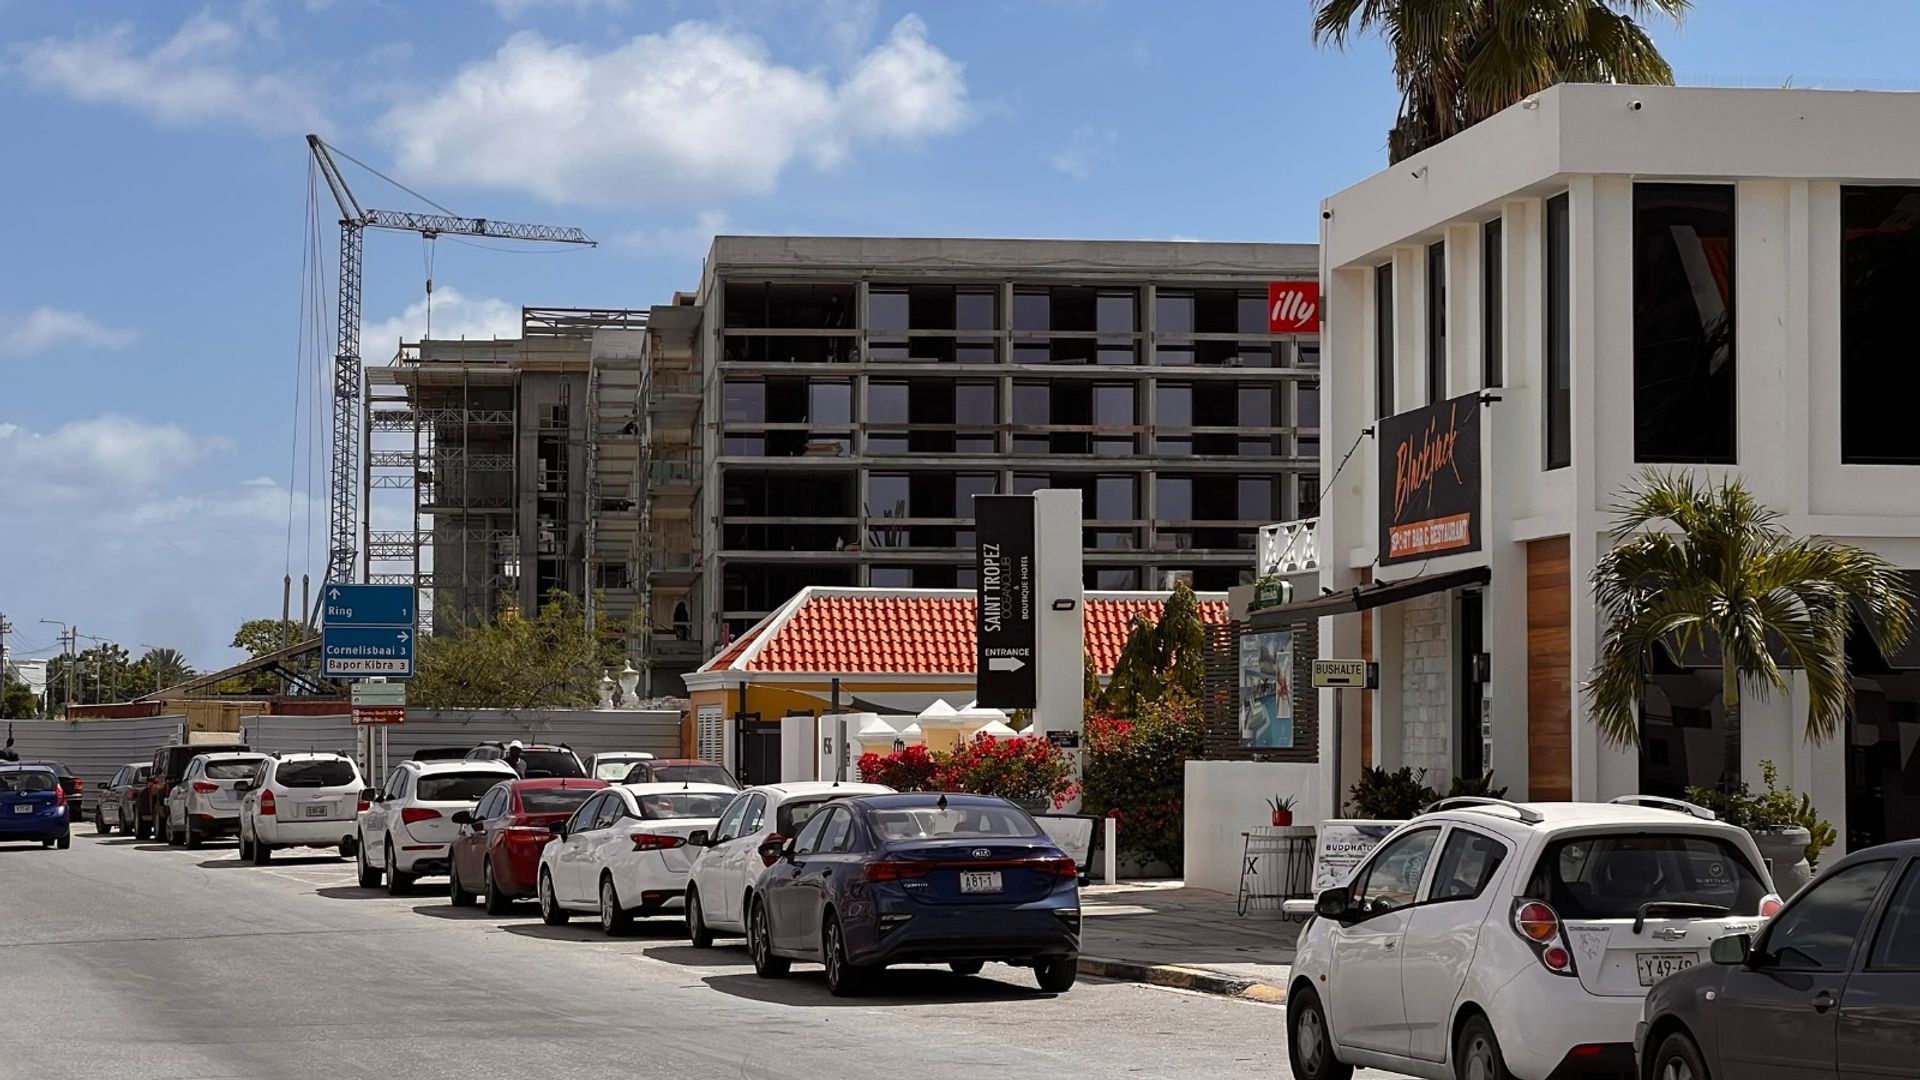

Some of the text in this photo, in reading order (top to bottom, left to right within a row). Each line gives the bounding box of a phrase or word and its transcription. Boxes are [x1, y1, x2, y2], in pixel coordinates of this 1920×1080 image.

[1272, 290, 1316, 328] illy
[1394, 402, 1463, 523] Blackjack
[1412, 527, 1424, 547] BAR
[1430, 519, 1468, 544] RESTAURANT
[983, 543, 1001, 632] SAINT TROPEZ
[1001, 556, 1013, 620] OCEANCLUB
[1020, 556, 1030, 620] BOUTIQUE HOTEL
[328, 606, 407, 618] Ring 1
[326, 645, 406, 655] Cornelisbaai 3
[985, 648, 1030, 656] ENTRANCE
[329, 660, 406, 671] Bapor Kibra 3
[1316, 663, 1362, 674] BUSHALTE
[1325, 843, 1378, 852] BUDDHATO
[1645, 960, 1653, 976] Y
